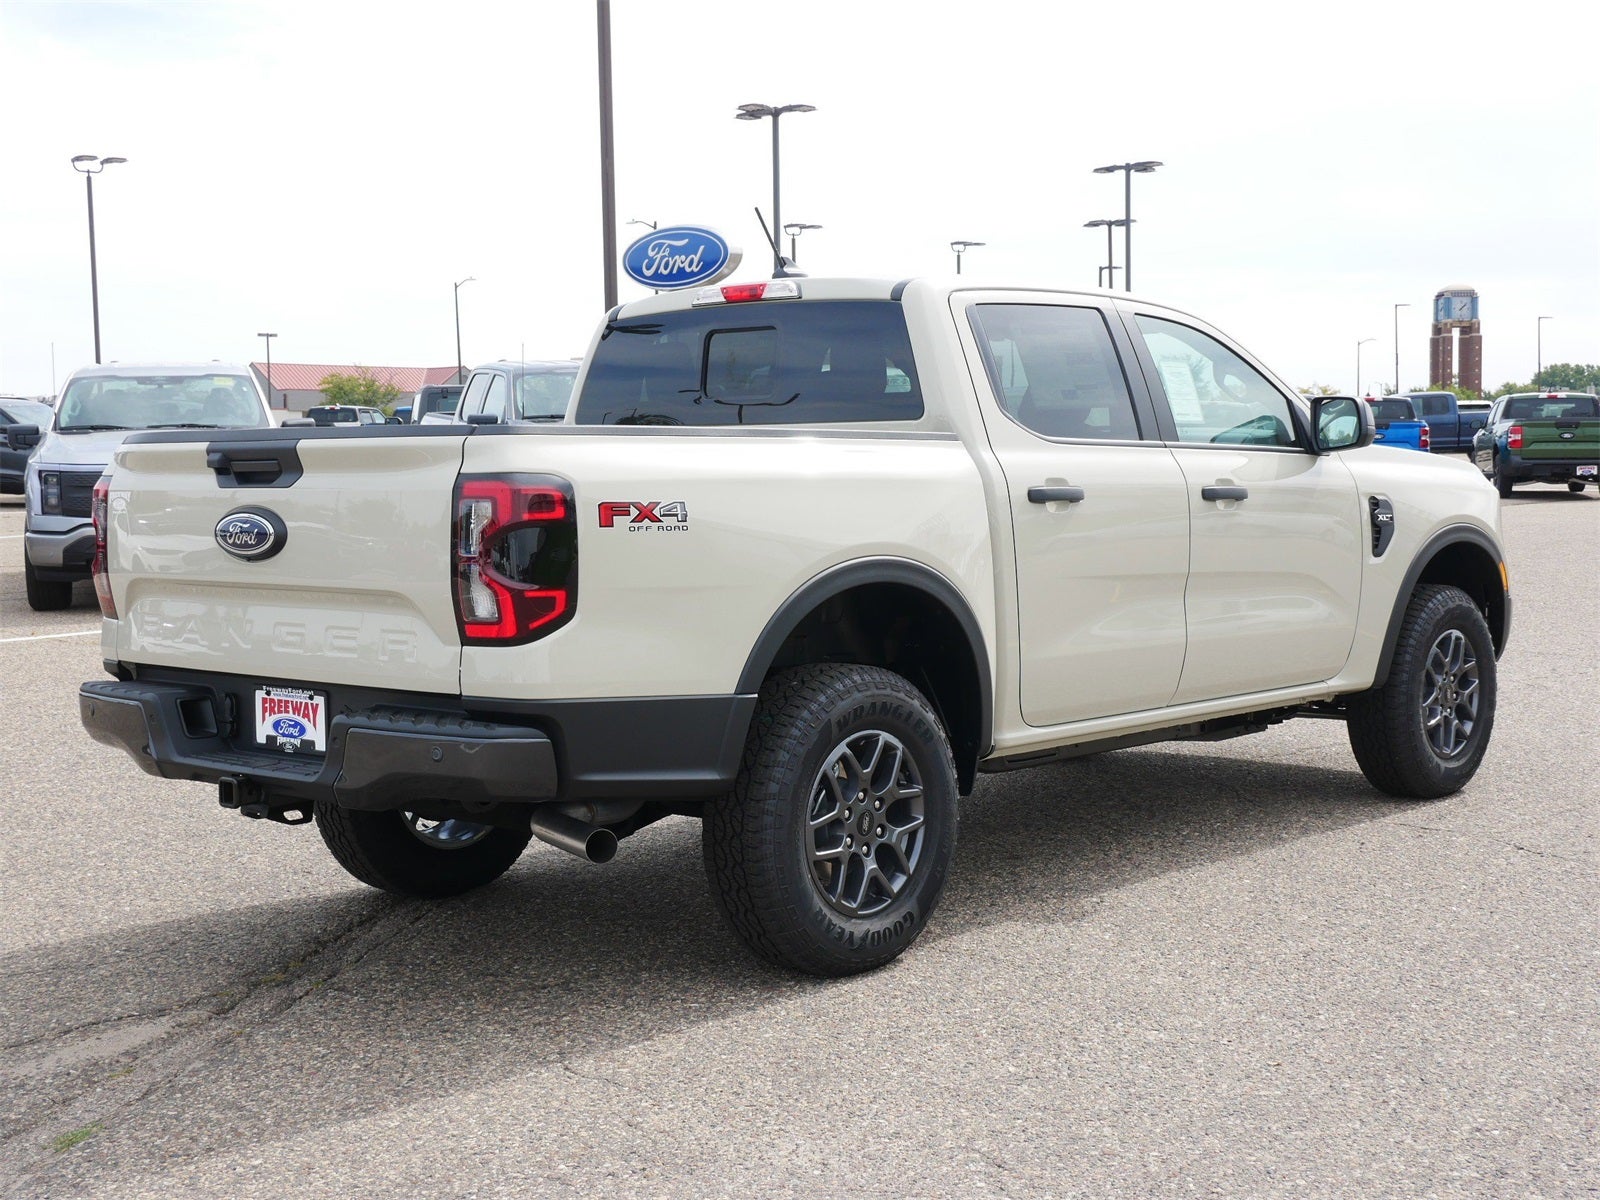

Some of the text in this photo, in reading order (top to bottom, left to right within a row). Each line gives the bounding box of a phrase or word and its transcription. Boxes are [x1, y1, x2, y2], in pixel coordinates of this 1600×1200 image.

[642, 238, 705, 277] Ford
[598, 501, 688, 528] FX4
[1377, 514, 1393, 522] XLT
[226, 521, 258, 545] Ford
[137, 612, 418, 663] RANGER
[261, 697, 319, 731] FREEWAY
[278, 720, 299, 735] Ford
[836, 701, 935, 743] WRANGLER
[815, 908, 915, 951] GOODYEAR
